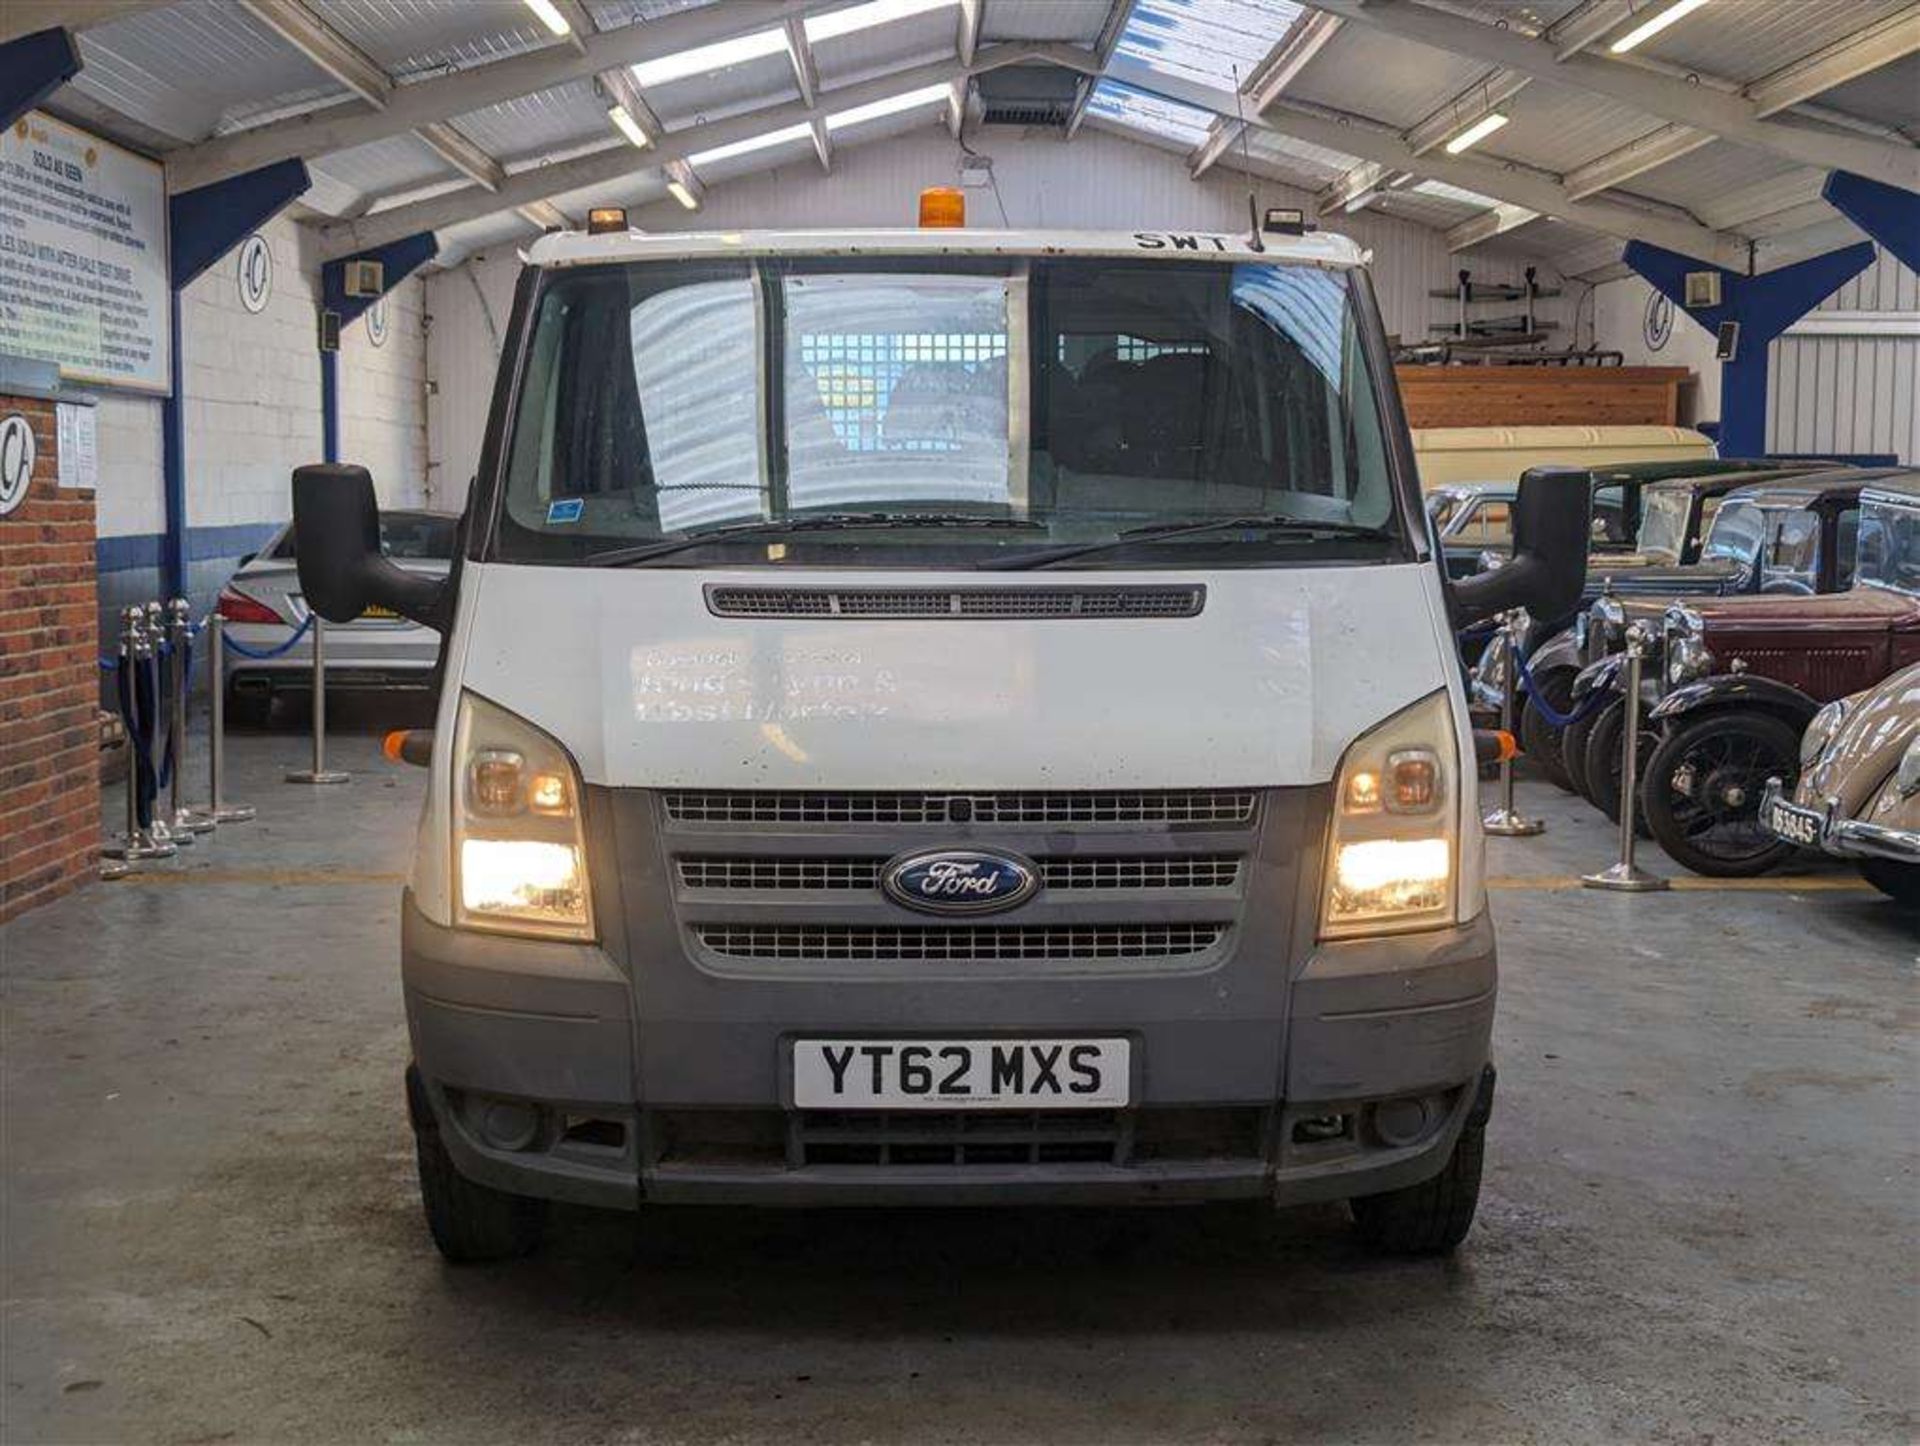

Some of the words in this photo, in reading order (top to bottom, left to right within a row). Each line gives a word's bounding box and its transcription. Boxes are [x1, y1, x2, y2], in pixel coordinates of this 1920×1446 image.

[1133, 232, 1226, 251] SWT
[921, 862, 999, 894] Ford
[822, 1045, 972, 1095] YT62
[991, 1045, 1102, 1095] MXS
